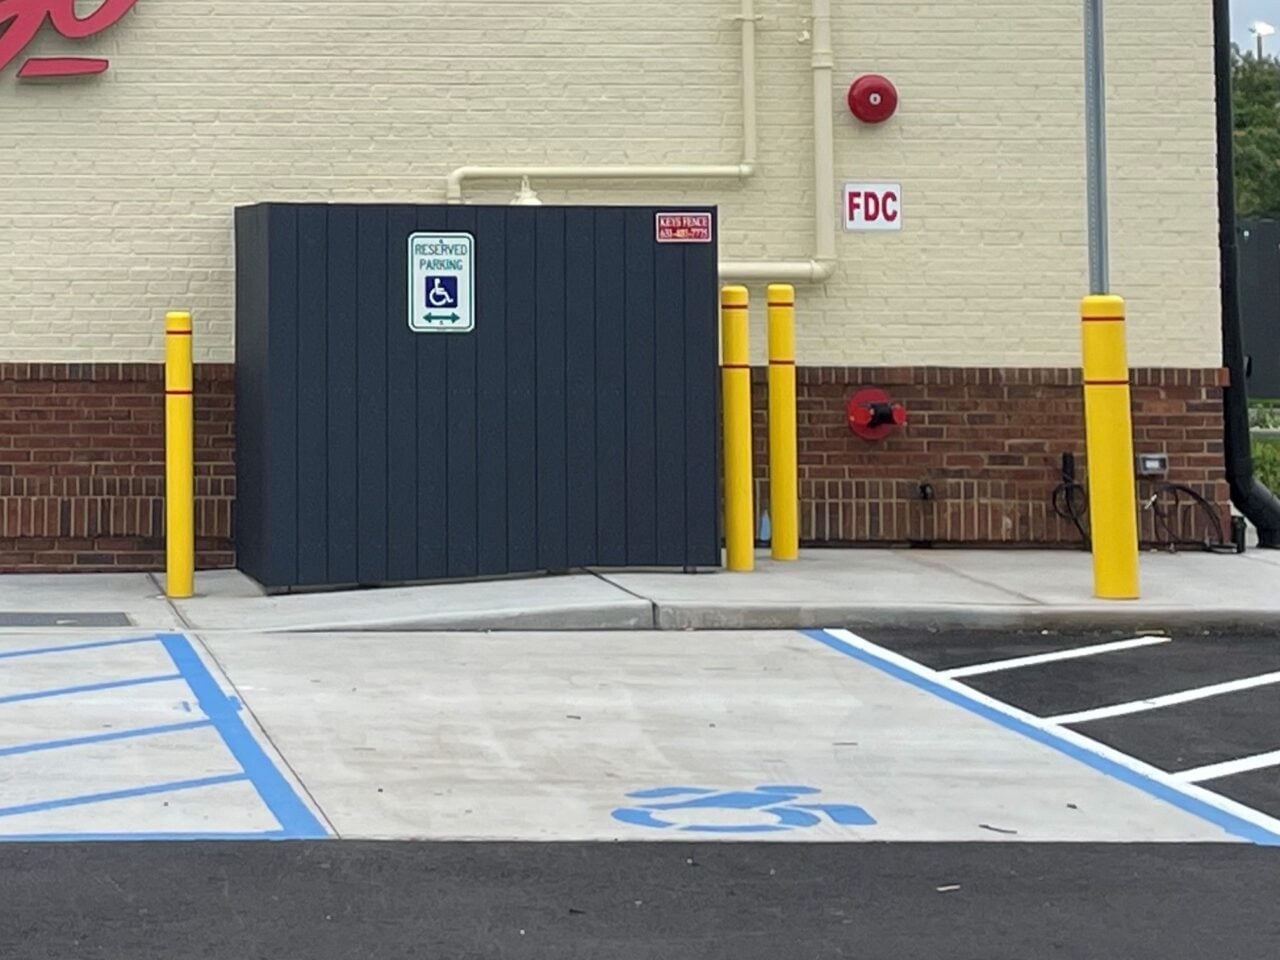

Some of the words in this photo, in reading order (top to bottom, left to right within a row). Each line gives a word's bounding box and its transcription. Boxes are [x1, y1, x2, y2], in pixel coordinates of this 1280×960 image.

[848, 191, 898, 222] FDC
[414, 243, 468, 256] RESERVED
[419, 258, 464, 271] PARKING
